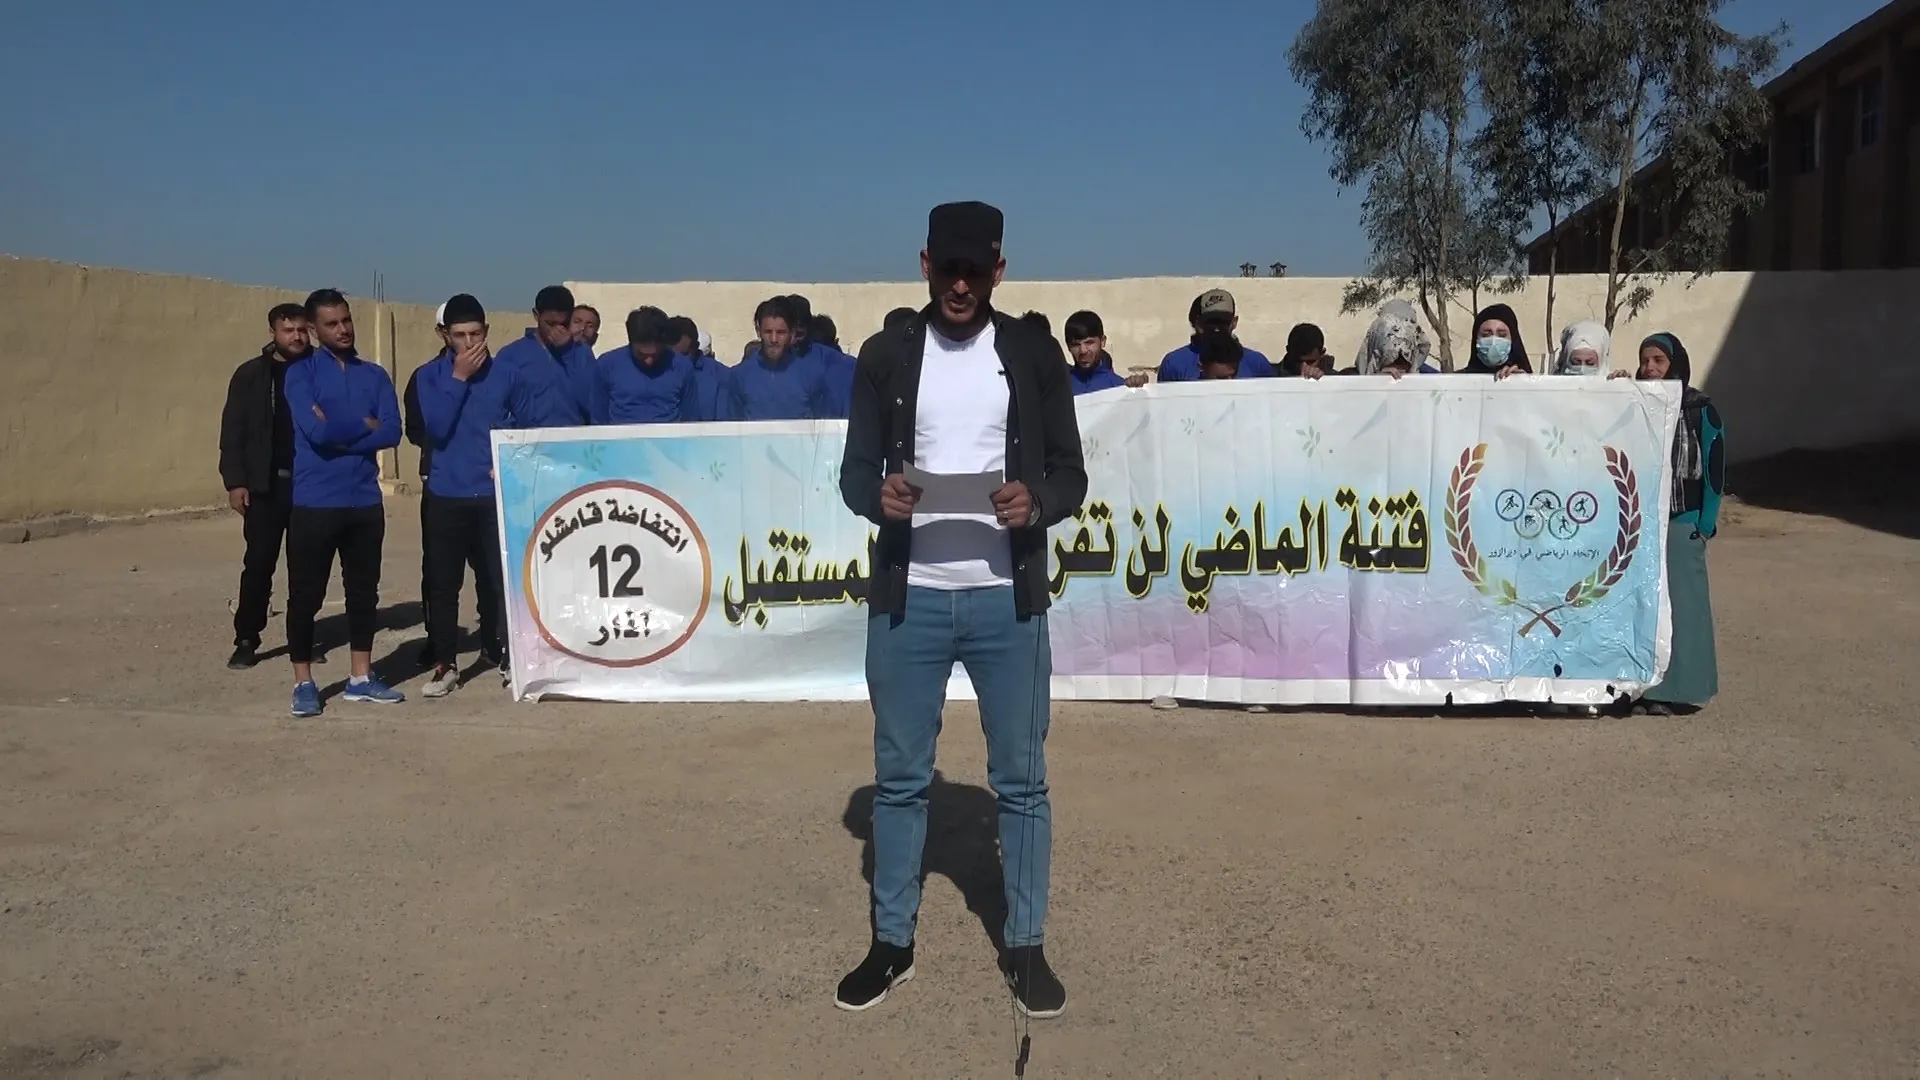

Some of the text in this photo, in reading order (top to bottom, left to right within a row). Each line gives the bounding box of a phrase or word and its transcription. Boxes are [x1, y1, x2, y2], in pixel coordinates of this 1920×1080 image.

[540, 498, 689, 563] انتفاضة قامشلو
[723, 487, 1430, 628] فتنة الماضي لن تفر لمستقبل
[1519, 547, 1532, 560] في
[589, 544, 644, 598] 12
